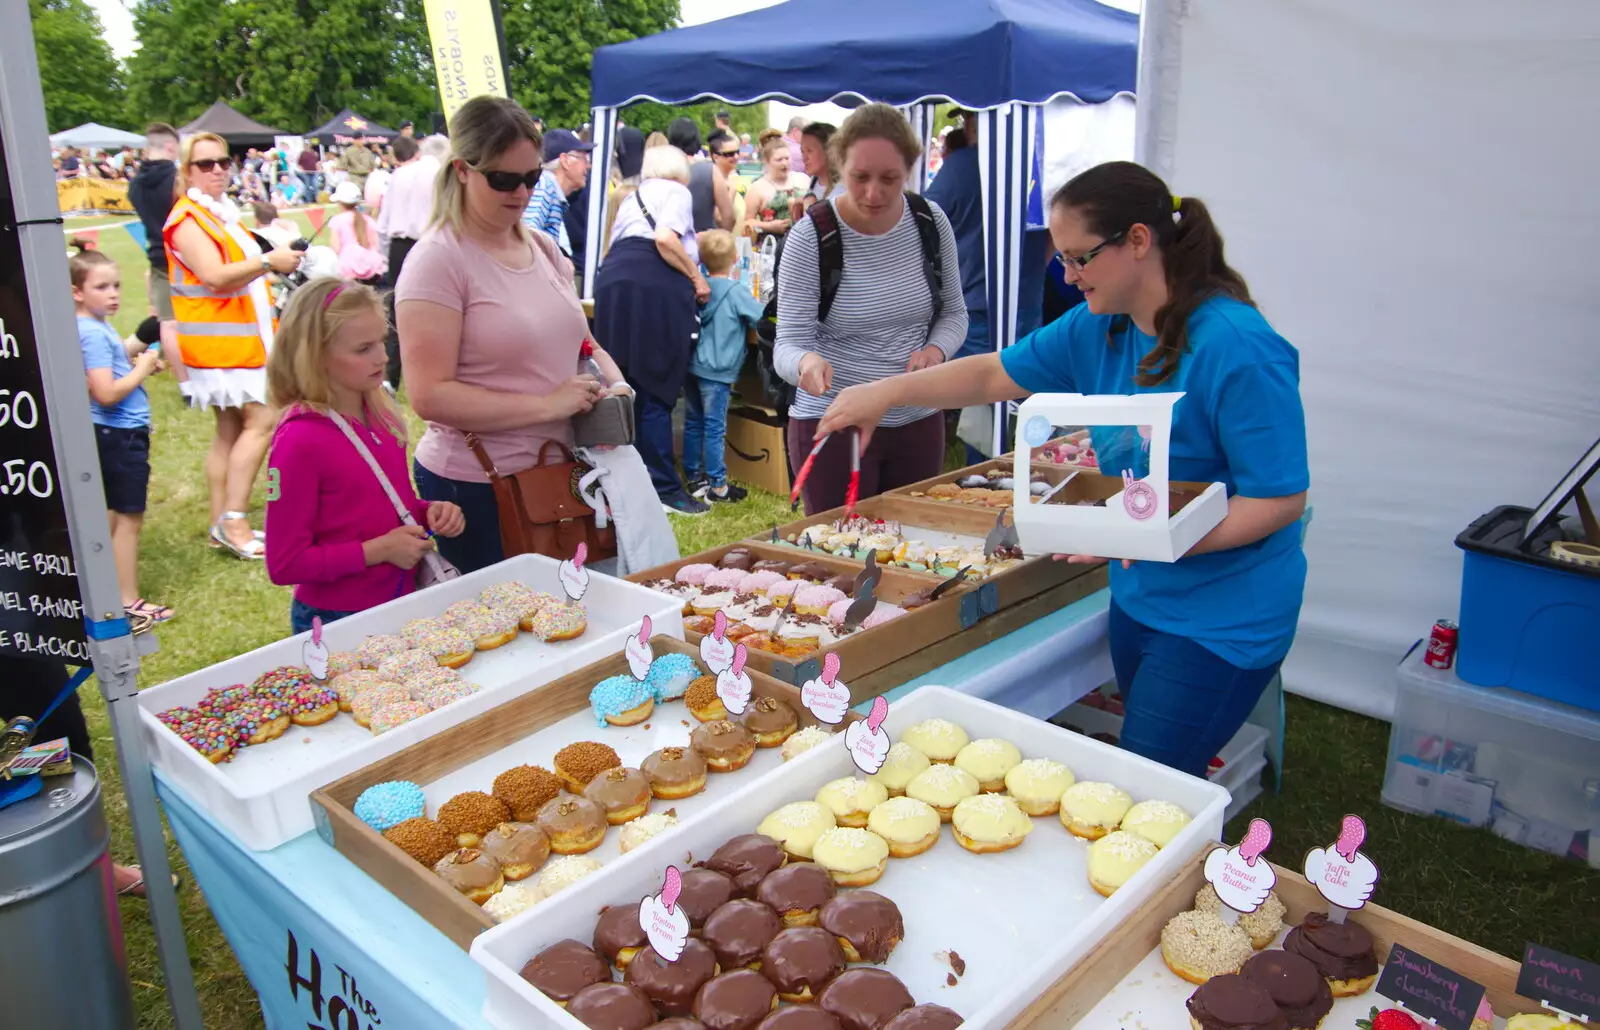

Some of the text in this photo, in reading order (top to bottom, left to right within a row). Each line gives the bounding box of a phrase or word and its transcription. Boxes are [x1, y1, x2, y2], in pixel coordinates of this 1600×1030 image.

[859, 734, 876, 750] Zesty
[1223, 861, 1257, 884] Peanut
[1324, 862, 1352, 878] Jaffa
[1222, 872, 1252, 892] Butter
[1323, 873, 1348, 888] Cake
[652, 910, 676, 932] Boston
[333, 963, 381, 1025] The
